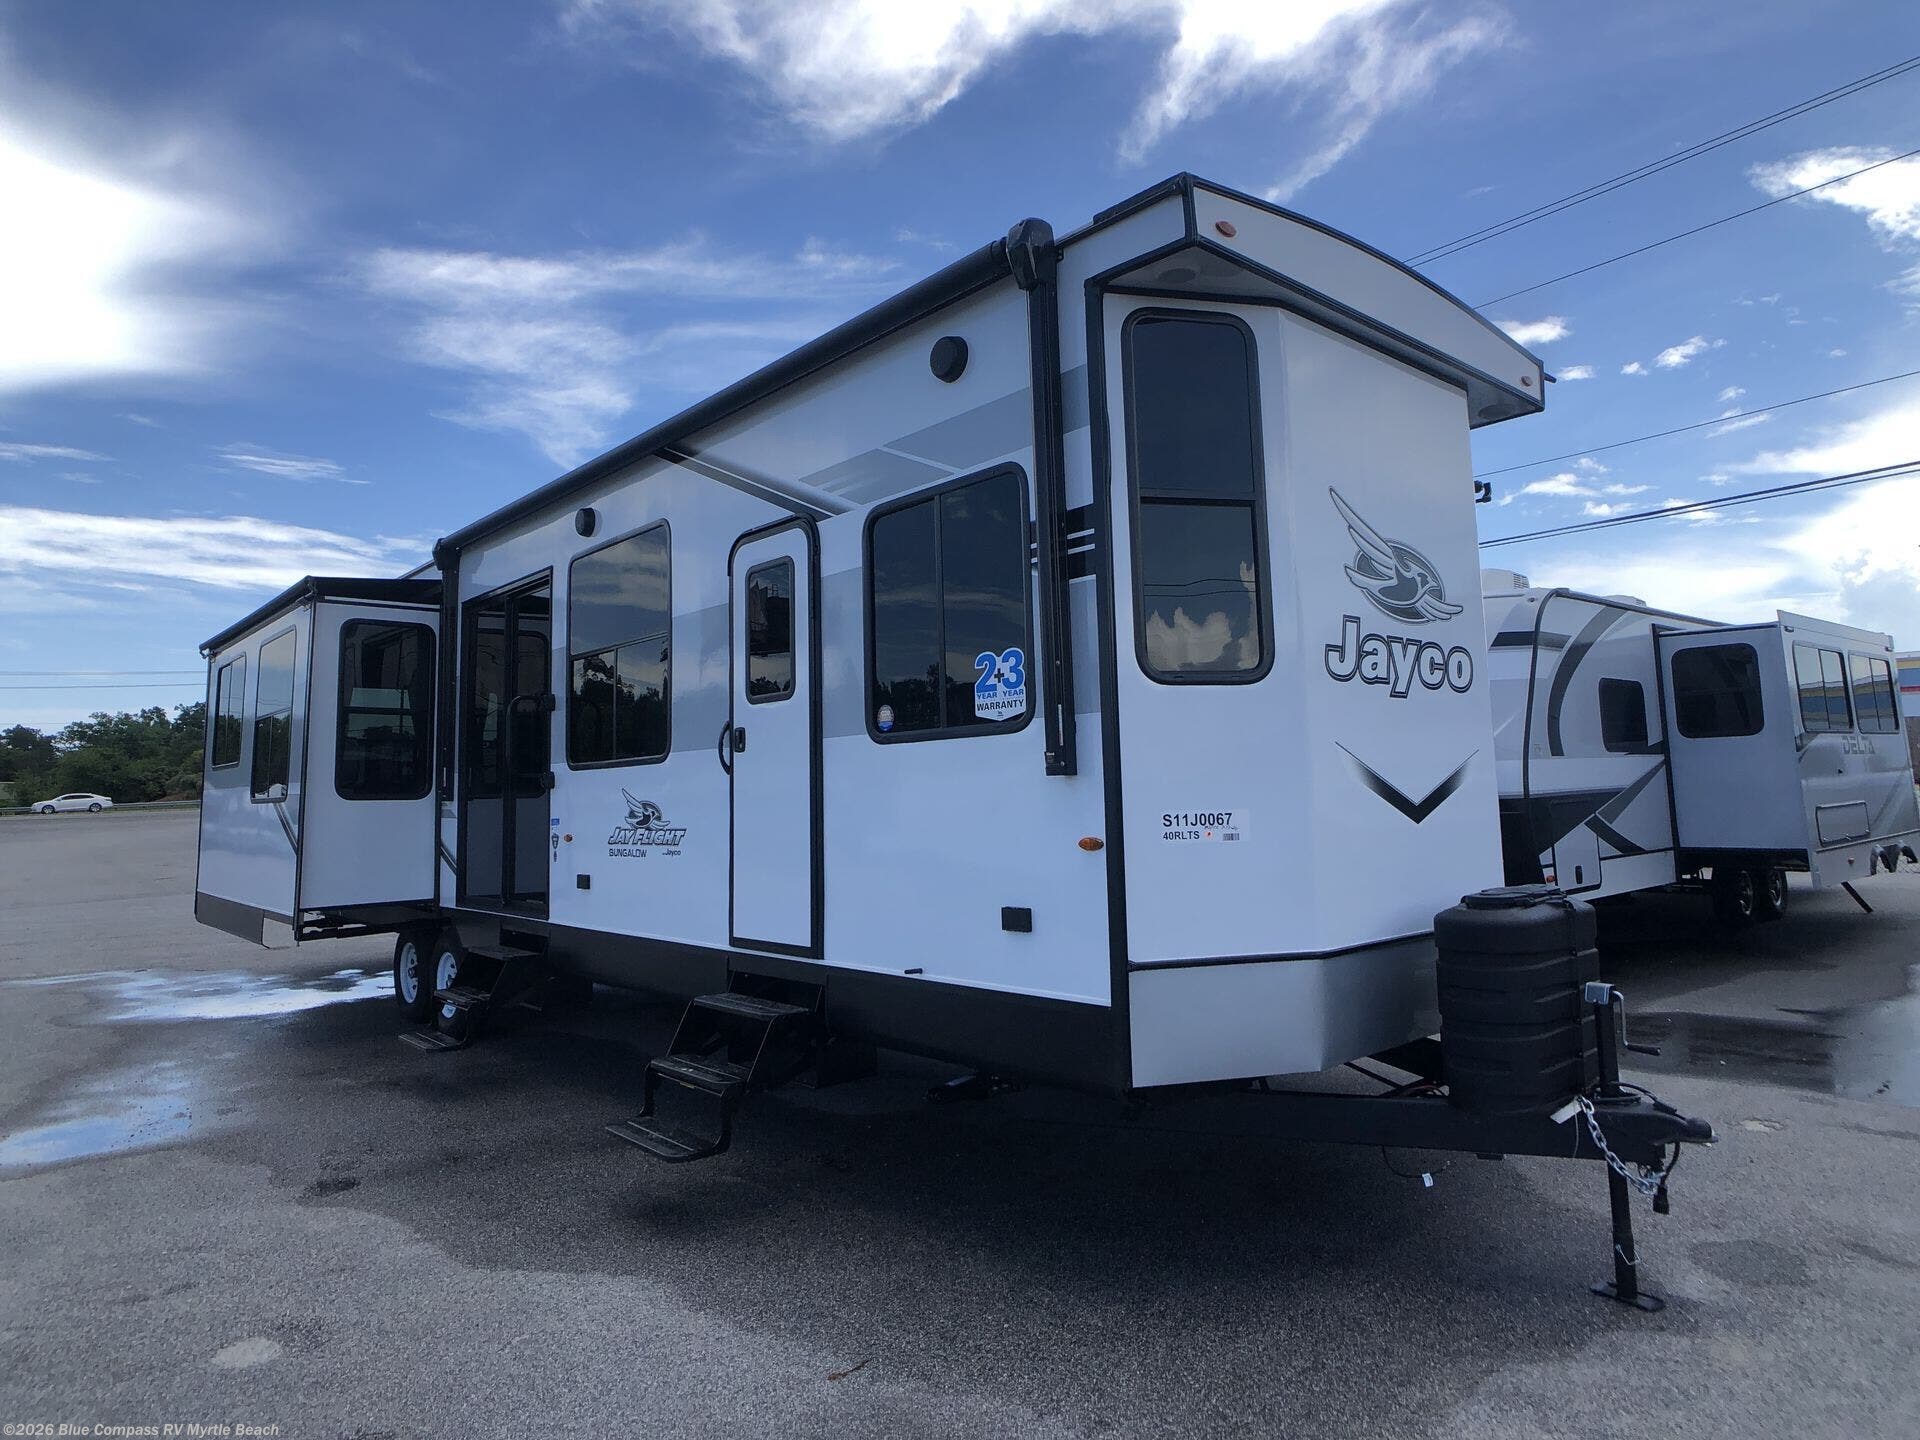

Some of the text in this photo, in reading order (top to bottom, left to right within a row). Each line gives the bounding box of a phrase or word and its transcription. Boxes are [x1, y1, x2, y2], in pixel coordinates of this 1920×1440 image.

[1324, 614, 1474, 699] Jayco
[1002, 688, 1024, 697] YEAR
[976, 699, 1024, 711] WARRANTY
[1163, 812, 1232, 827] S11J0067
[1163, 831, 1200, 840] 40RLTS
[608, 848, 647, 857] BUNGALOW
